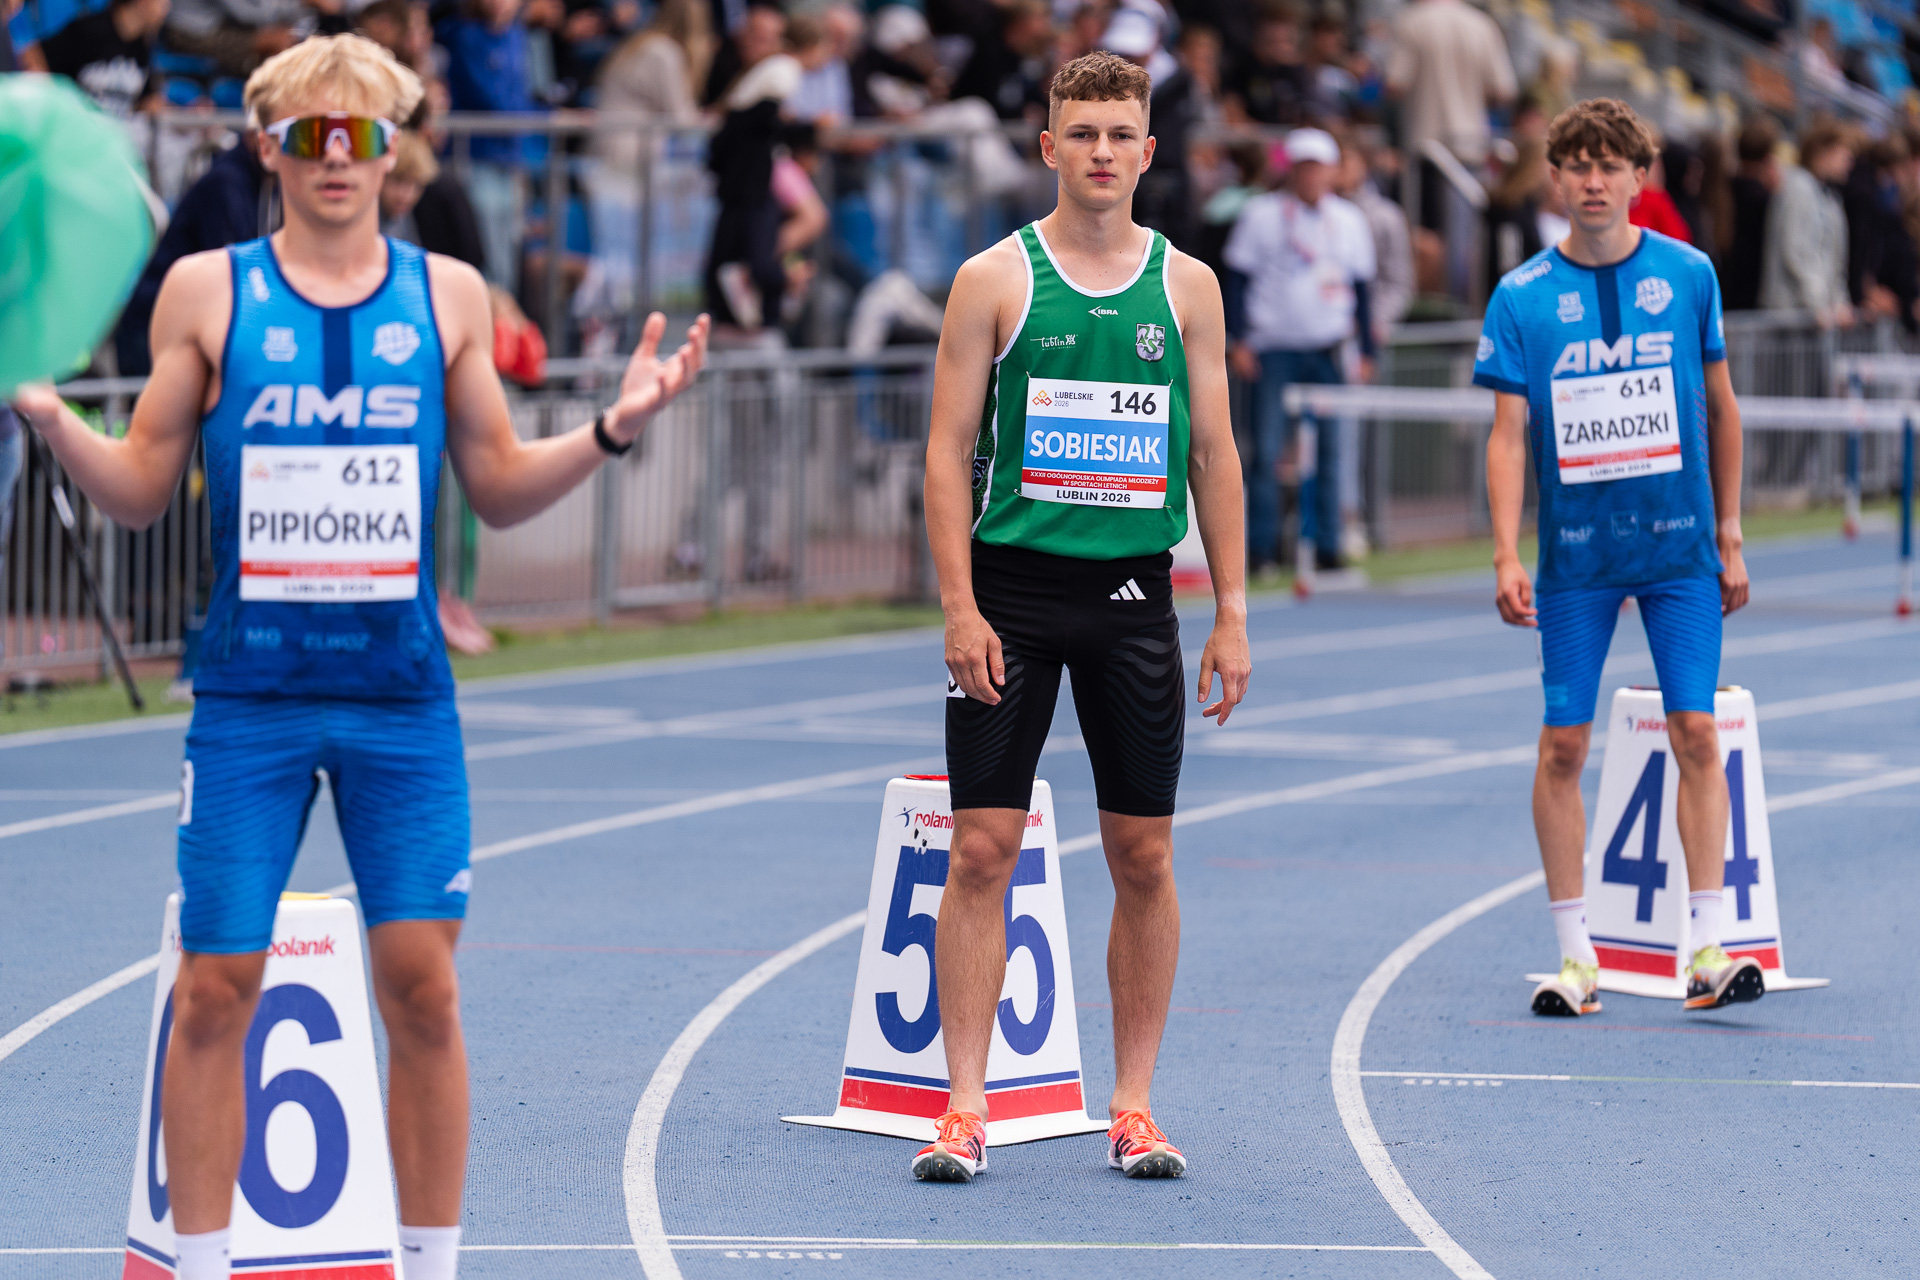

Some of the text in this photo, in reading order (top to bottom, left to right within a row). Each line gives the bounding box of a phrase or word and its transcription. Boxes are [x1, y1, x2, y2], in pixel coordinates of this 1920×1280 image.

[1551, 331, 1674, 376] AMS
[1054, 391, 1094, 401] LUBELSKIE
[1110, 390, 1157, 415] 146
[1620, 374, 1662, 399] 614
[242, 384, 422, 430] AMS
[1054, 400, 1070, 408] 2026
[1562, 411, 1669, 446] ZARADZKI
[1029, 430, 1162, 464] SOBIESIAK
[342, 456, 402, 486] 612
[1046, 472, 1095, 481] OGÓLNOPOLSKA
[1096, 475, 1128, 484] OLIMPIADA
[1128, 477, 1160, 485] MŁODZIEŻY
[1070, 480, 1103, 488] SPORTACH
[1056, 489, 1131, 503] LUBLIN 2026
[248, 502, 412, 544] PIPIÓRKA
[1602, 749, 1668, 923] 4
[875, 845, 950, 1054] 5
[997, 847, 1056, 1056] 5
[237, 982, 350, 1229] 6
